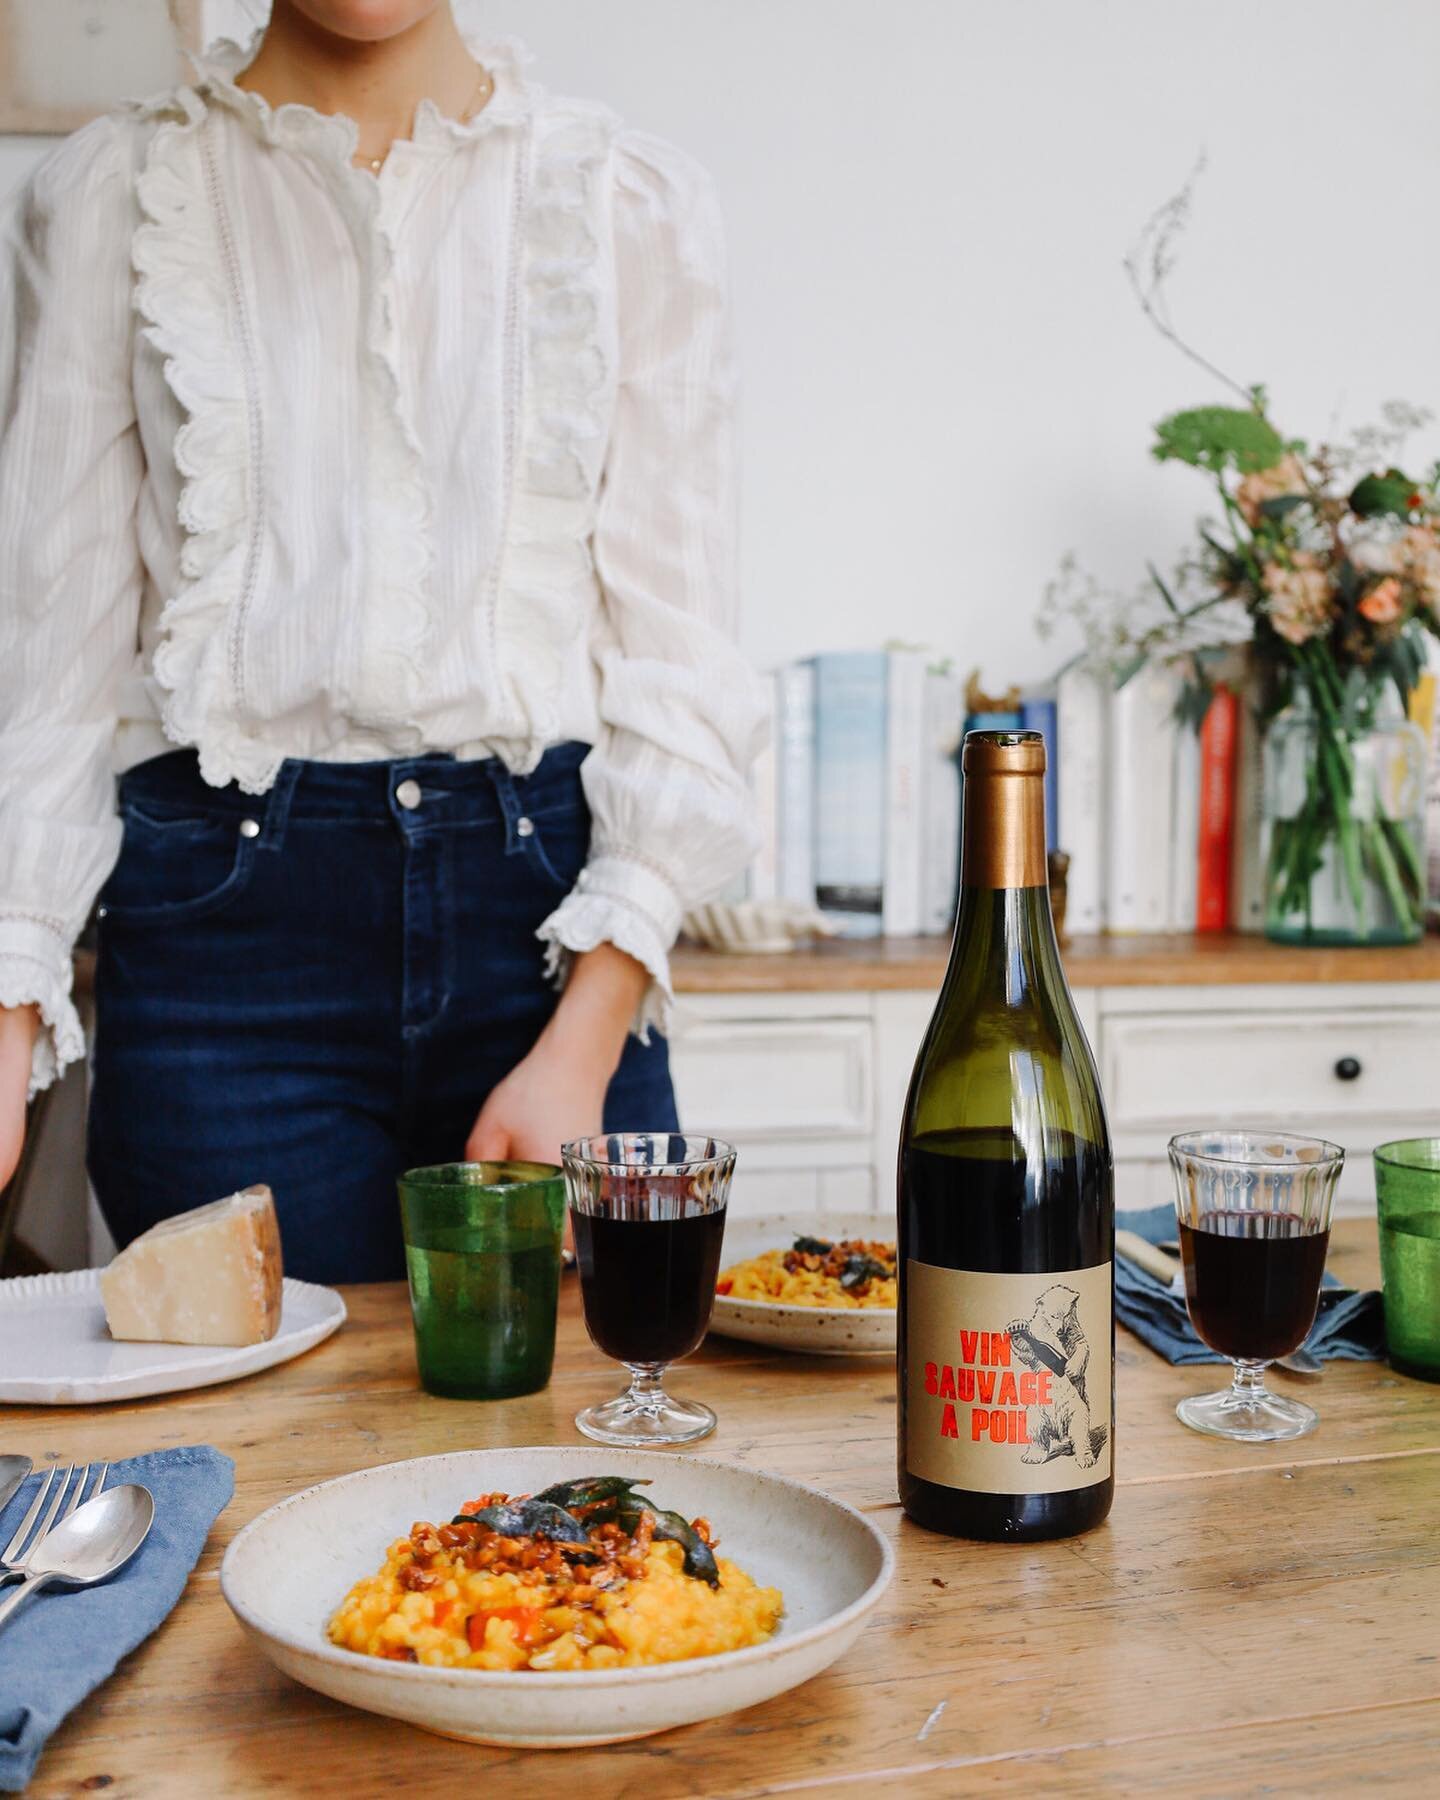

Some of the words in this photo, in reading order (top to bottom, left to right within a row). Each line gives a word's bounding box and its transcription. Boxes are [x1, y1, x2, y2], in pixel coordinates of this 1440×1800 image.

[960, 1329, 1012, 1367] VIN
[924, 1361, 1053, 1406] SAUVAGE
[940, 1403, 960, 1440] A
[971, 1408, 1032, 1444] POIL
